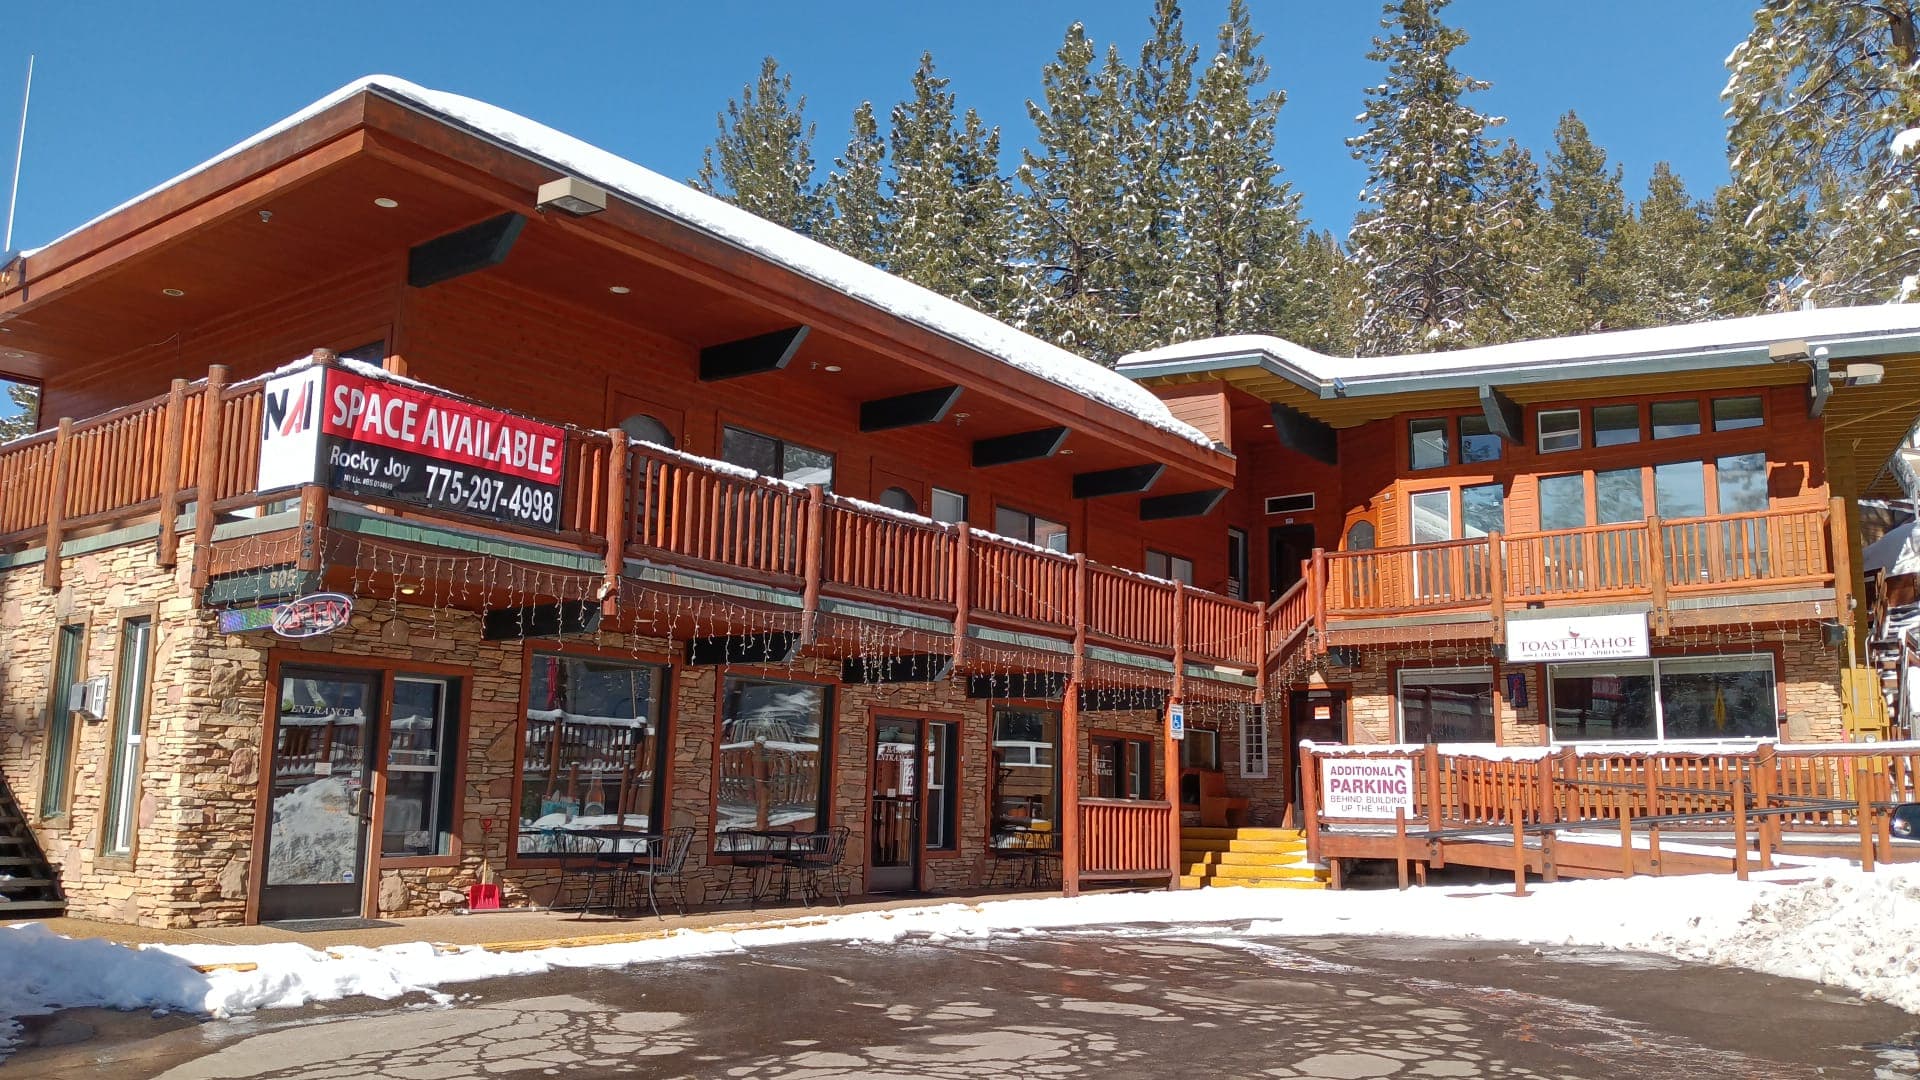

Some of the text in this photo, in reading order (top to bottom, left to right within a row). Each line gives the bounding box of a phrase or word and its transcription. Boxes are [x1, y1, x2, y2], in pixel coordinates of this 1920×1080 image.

[264, 379, 313, 440] NAI
[332, 385, 556, 474] SPACE AVAILABLE
[330, 445, 410, 482] Rocky Joy
[426, 465, 554, 523] 775-297-4998
[1519, 637, 1637, 652] TOAST TAHOE
[291, 704, 351, 717] ENTRANCE
[1330, 766, 1393, 776] ADDITIONAL
[1330, 779, 1407, 794] PARKING
[1330, 795, 1407, 804] BEHIND BUILDING
[1376, 805, 1394, 813] HILL
